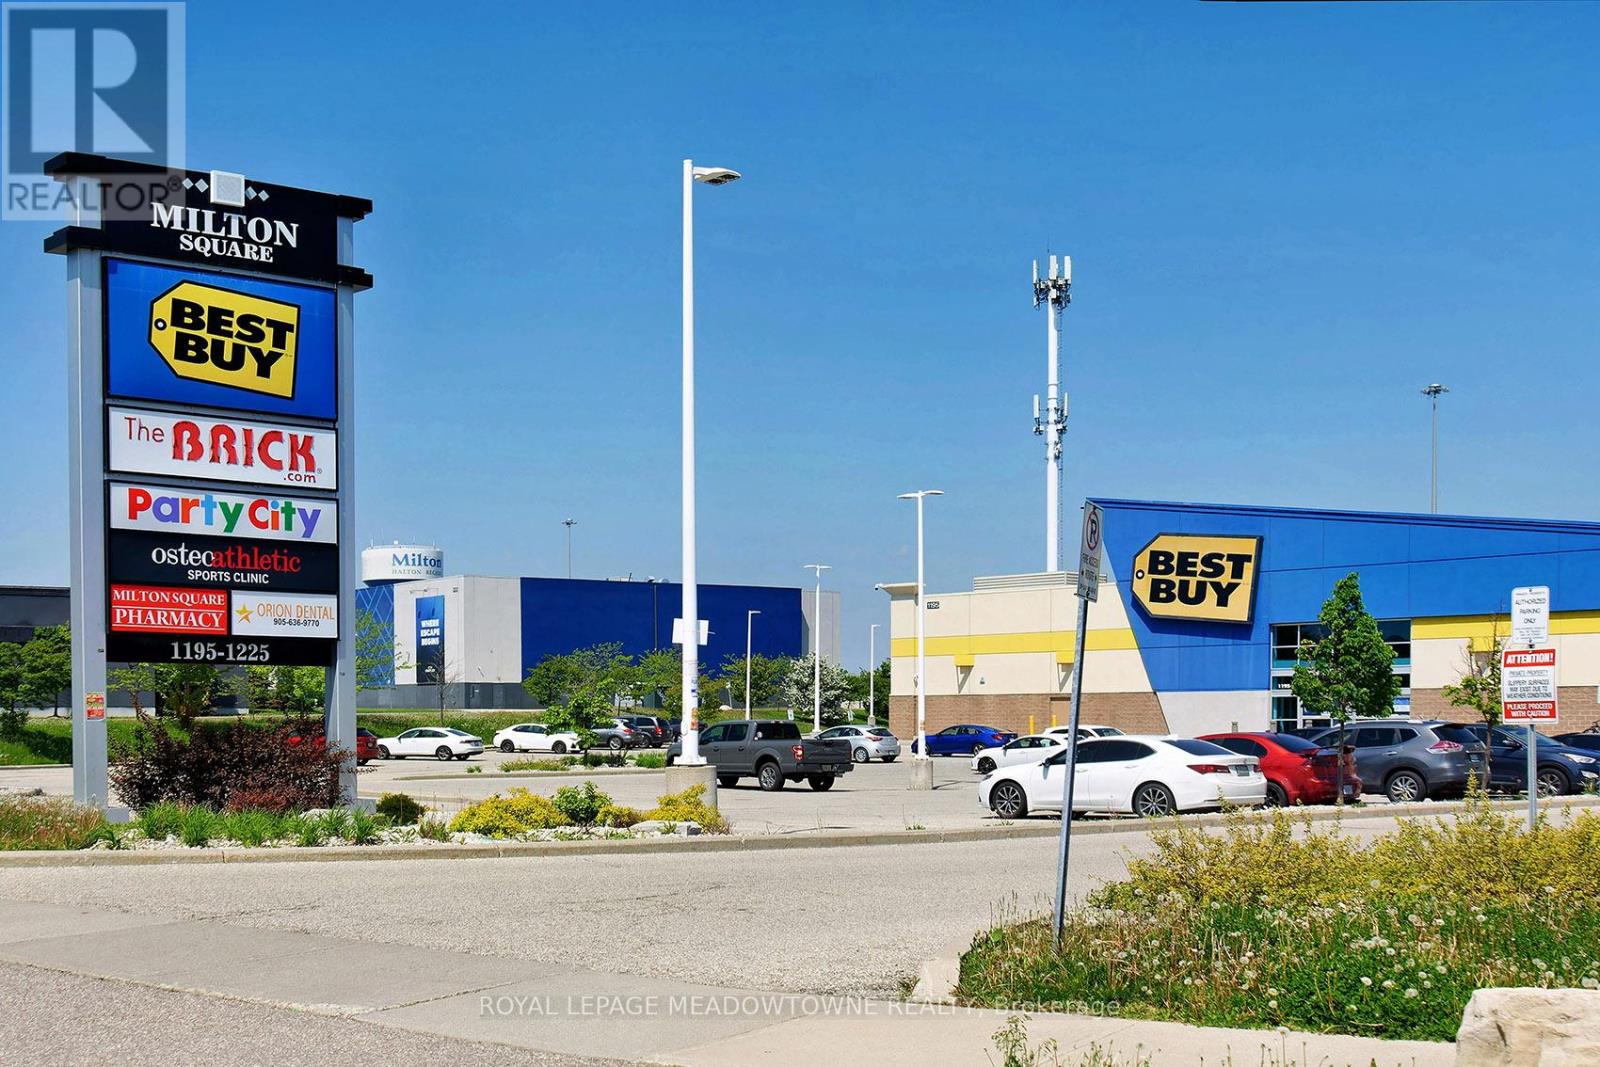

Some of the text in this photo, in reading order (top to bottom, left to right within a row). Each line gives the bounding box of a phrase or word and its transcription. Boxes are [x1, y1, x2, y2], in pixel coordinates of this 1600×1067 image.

[150, 202, 299, 248] MILTON
[179, 234, 273, 263] SQUARE
[170, 297, 295, 350] BEST
[173, 331, 285, 379] BUY
[124, 416, 317, 473] The BRICK
[283, 472, 317, 484] .com
[128, 488, 322, 539] Party City
[392, 553, 442, 568] Milton
[1147, 550, 1252, 580] BEST
[187, 569, 269, 584] SPORTS CLINIC
[113, 589, 225, 607] MILTON SQUARE
[1149, 578, 1241, 607] BUY
[115, 608, 224, 628] PHARMACY
[256, 603, 335, 620] ORION DENTAL
[170, 641, 270, 662] 1195-1225
[1506, 652, 1554, 664] ATTENTION!
